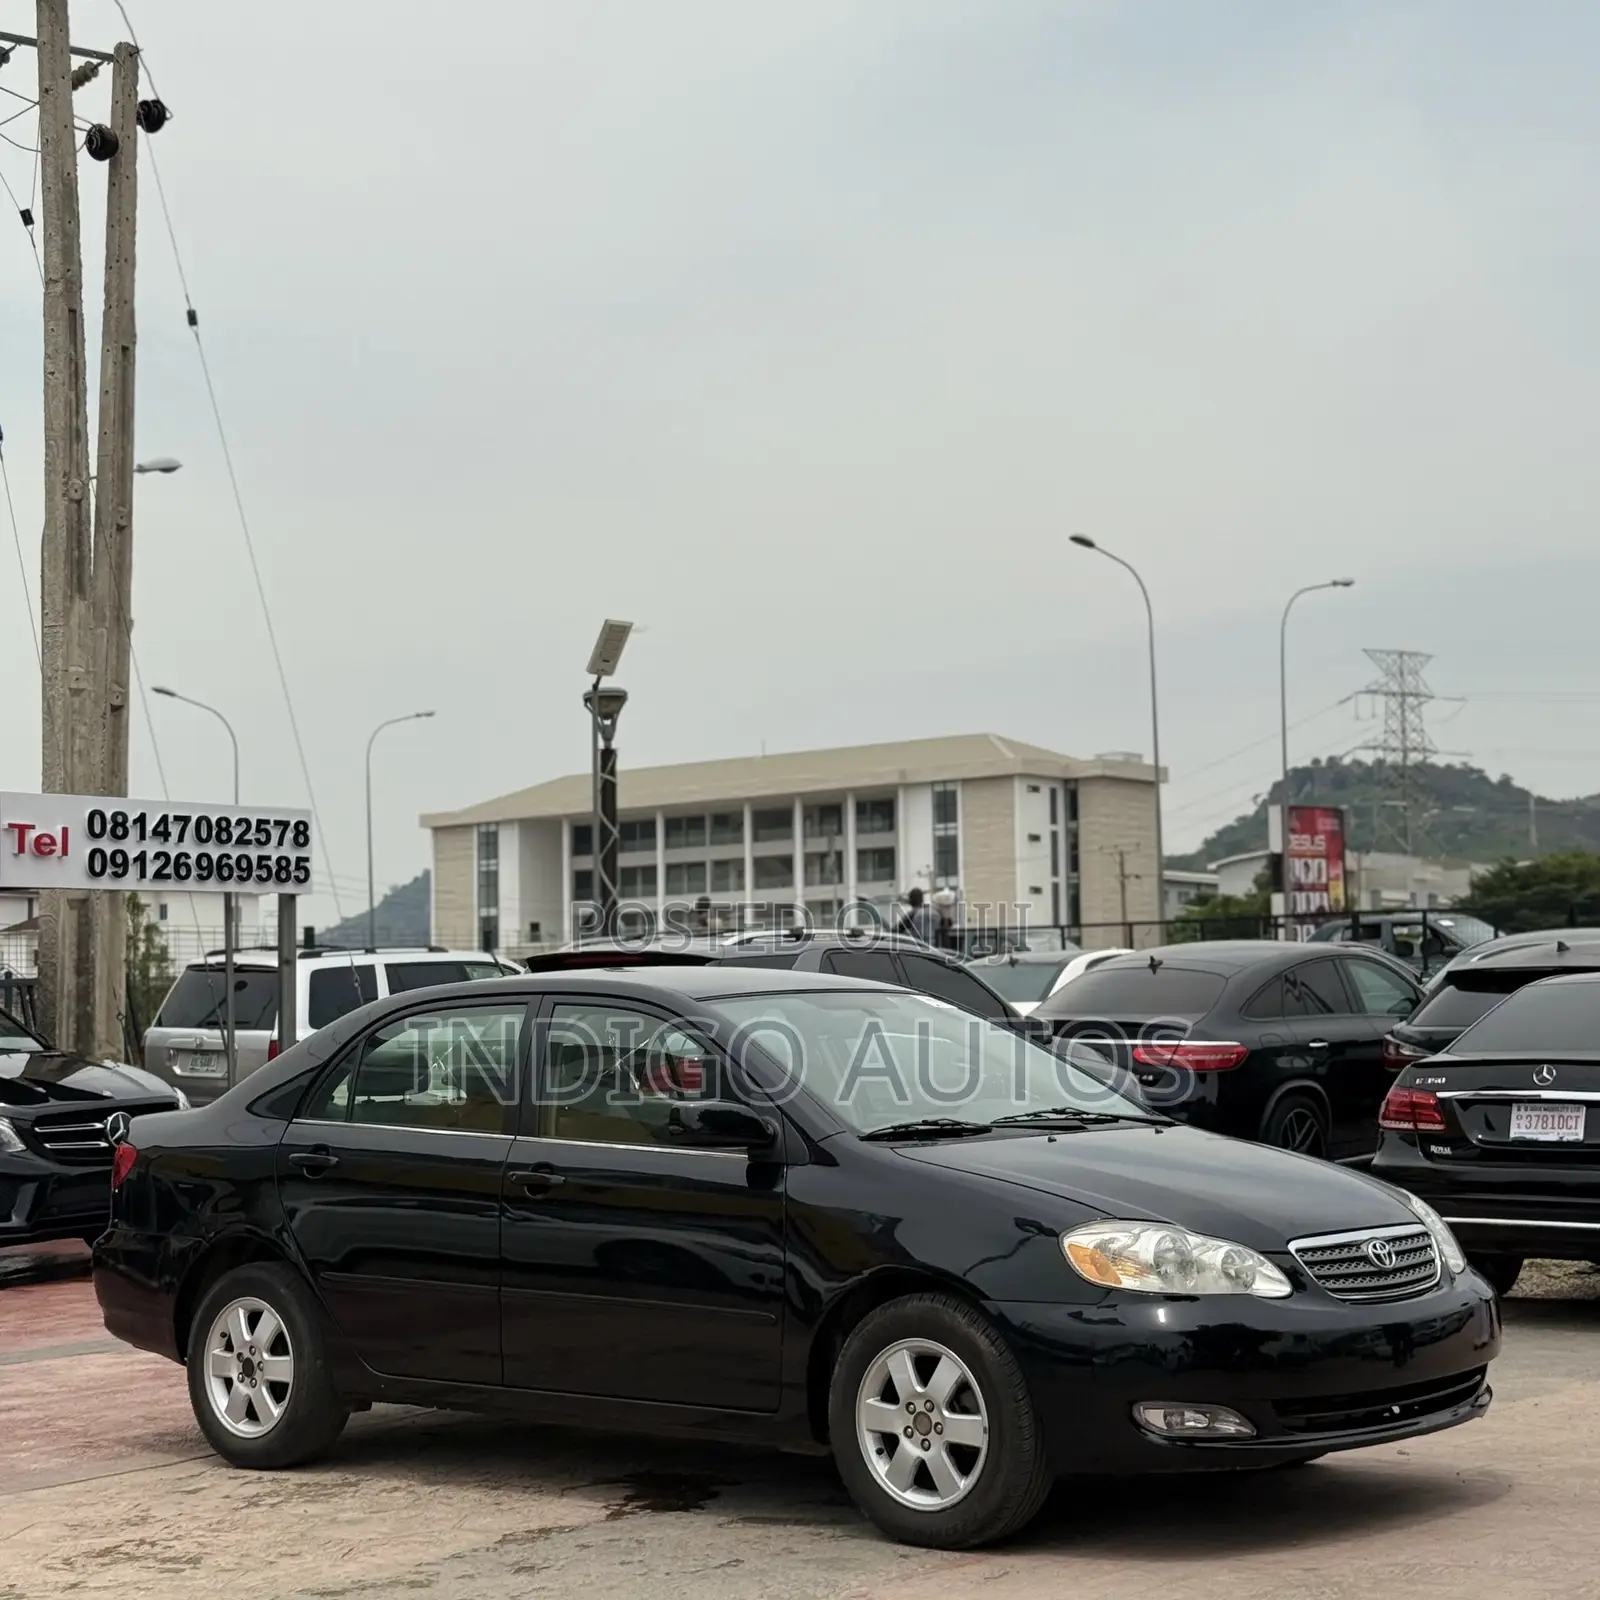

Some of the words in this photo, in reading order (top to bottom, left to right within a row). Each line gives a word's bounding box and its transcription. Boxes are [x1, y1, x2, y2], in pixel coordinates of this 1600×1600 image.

[7, 823, 69, 858] Tel
[87, 808, 311, 848] 08147082578
[87, 847, 311, 884] 09126969585
